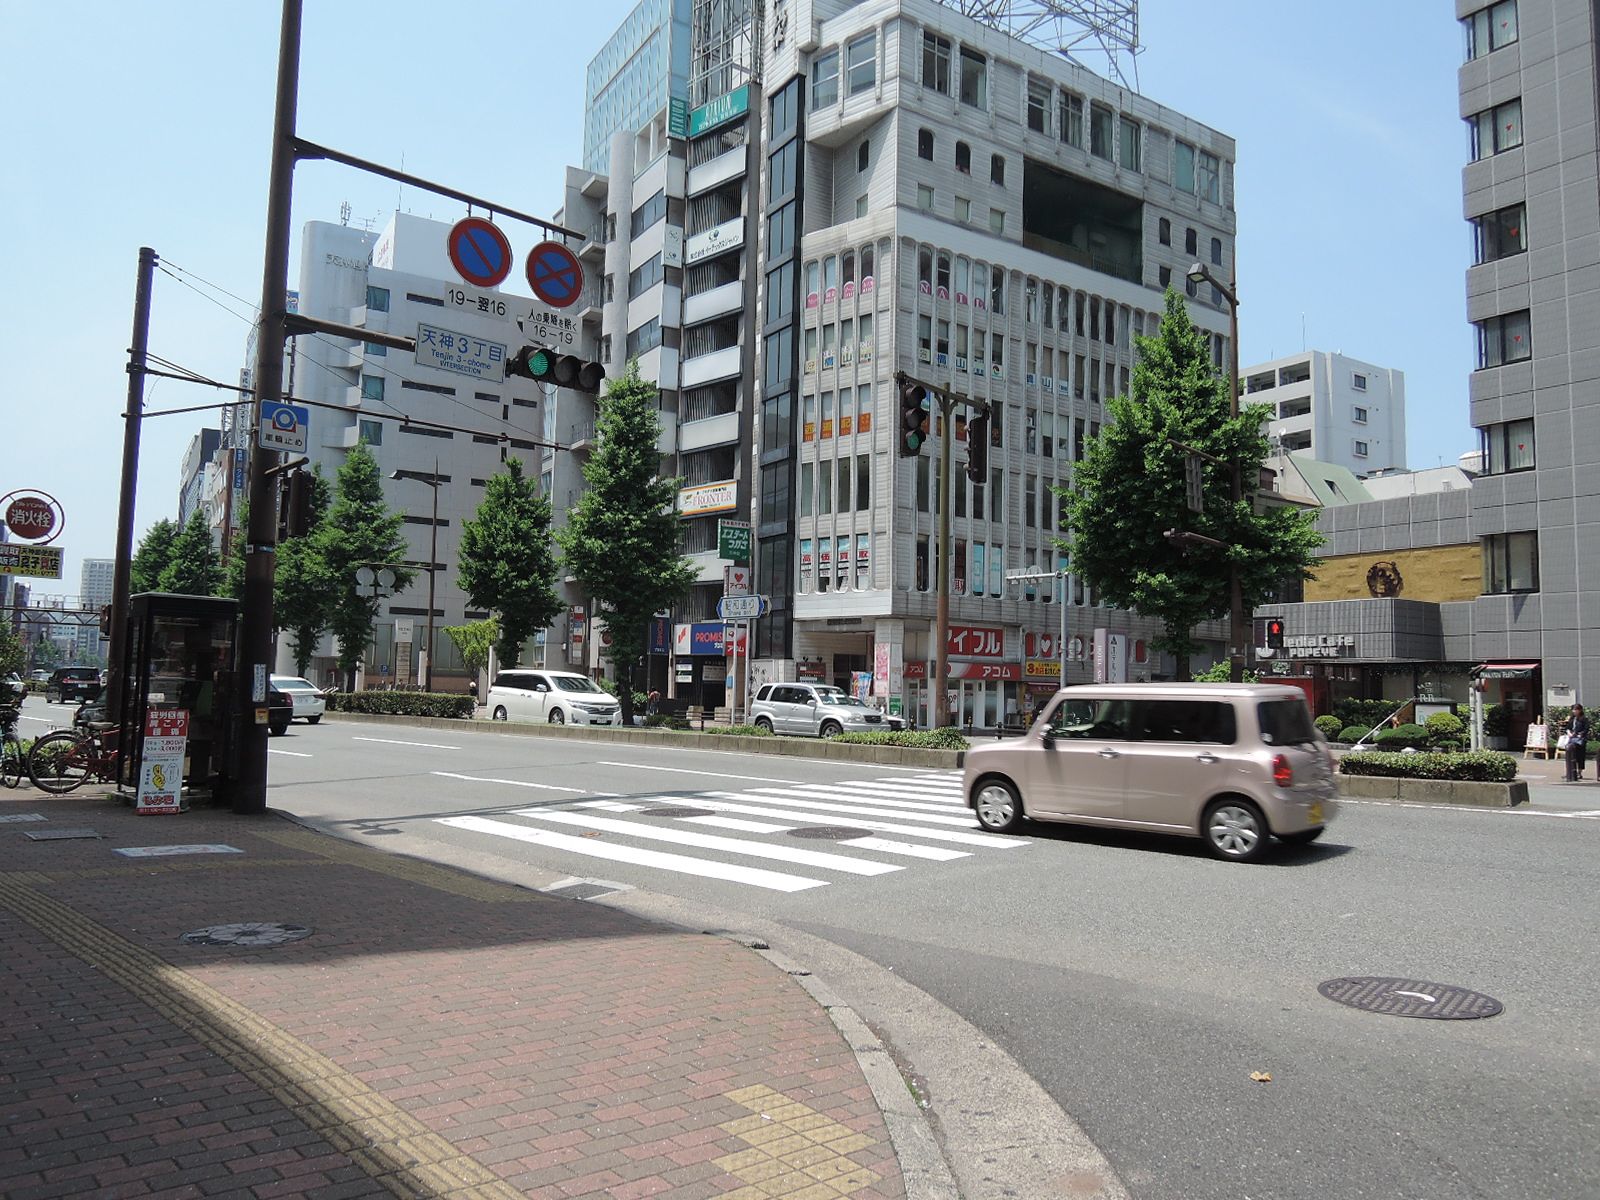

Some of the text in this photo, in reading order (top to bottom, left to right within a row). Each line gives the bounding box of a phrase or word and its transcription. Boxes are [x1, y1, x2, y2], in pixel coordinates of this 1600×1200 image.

[431, 348, 454, 362] Tenjin
[11, 508, 51, 528] 消火栓
[695, 632, 723, 643] PROMIS
[948, 629, 1001, 654] イフル
[1283, 636, 1316, 648] edia
[1289, 647, 1339, 658] POPEYE
[909, 664, 924, 673] アコム
[982, 666, 1011, 677] アコム
